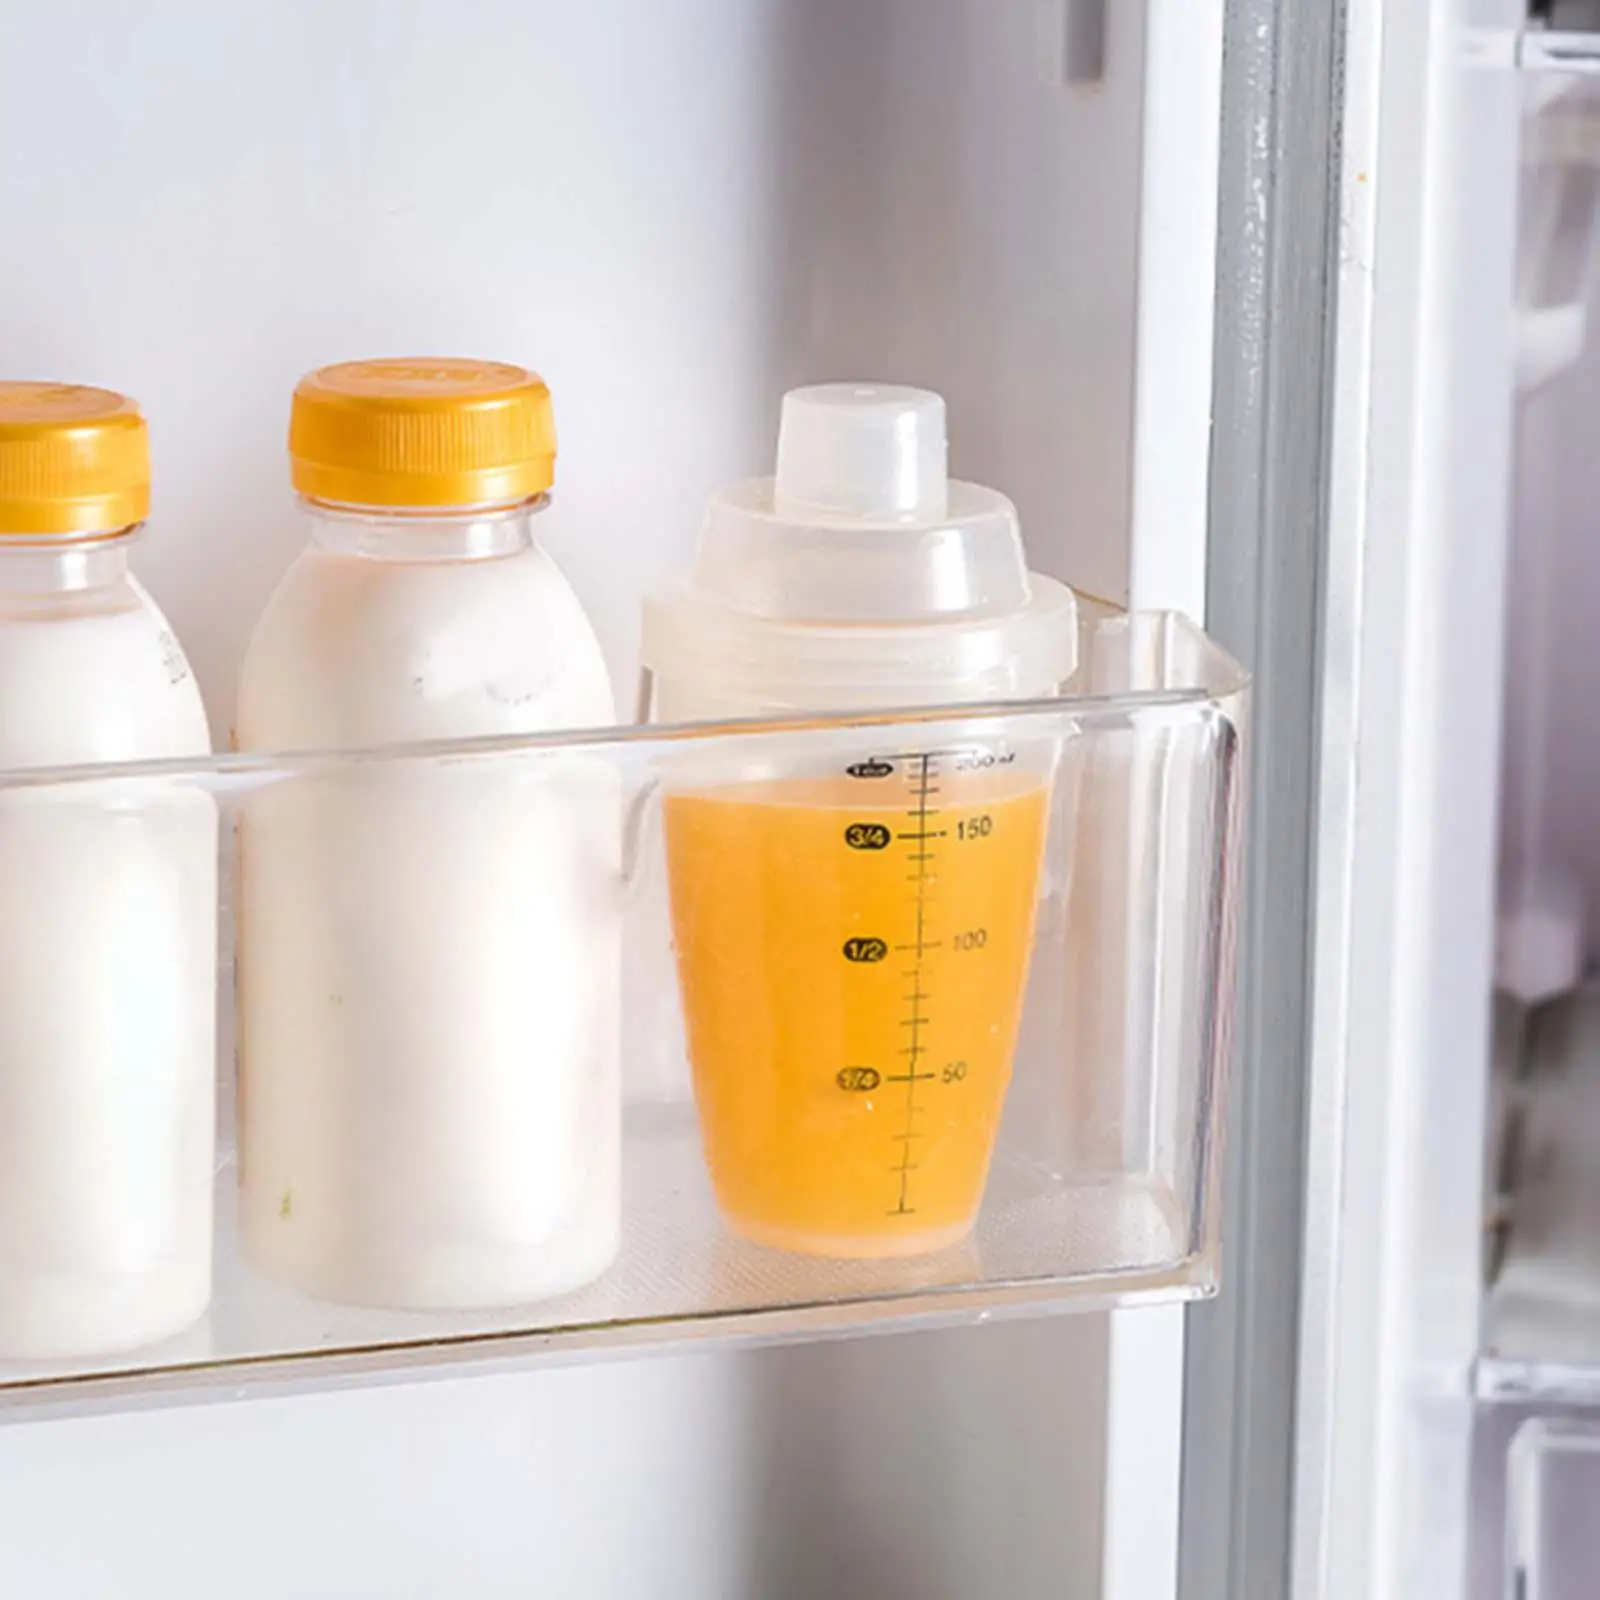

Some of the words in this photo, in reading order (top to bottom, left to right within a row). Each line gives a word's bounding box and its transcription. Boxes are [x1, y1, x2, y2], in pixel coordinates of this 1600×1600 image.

[848, 825, 885, 847] 3/4
[958, 815, 992, 840] 150
[846, 939, 884, 960] 1/2
[953, 928, 987, 951] 100
[942, 1061, 968, 1084] 50
